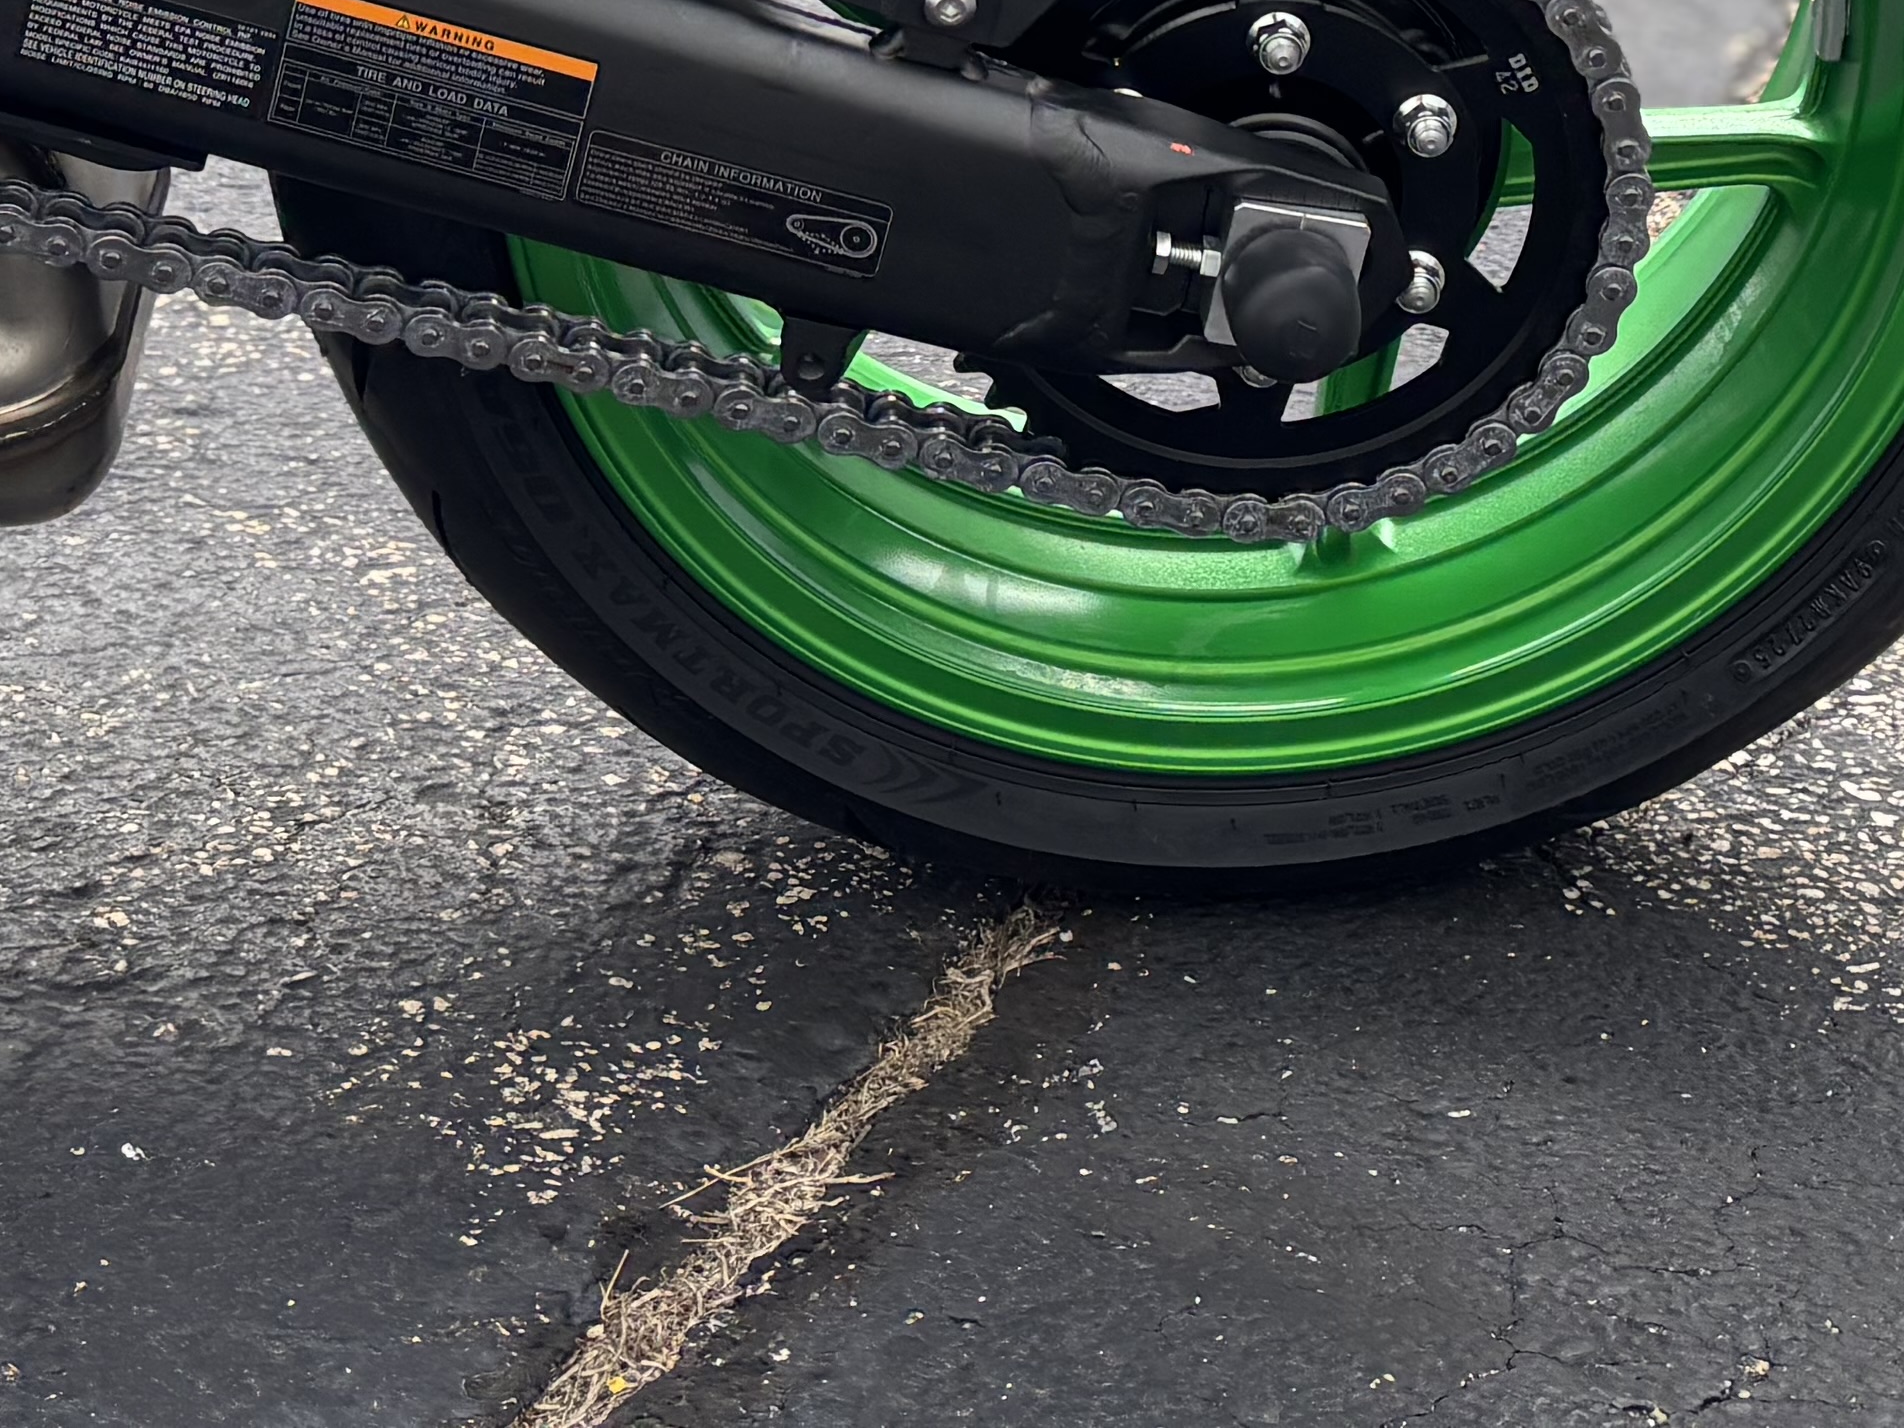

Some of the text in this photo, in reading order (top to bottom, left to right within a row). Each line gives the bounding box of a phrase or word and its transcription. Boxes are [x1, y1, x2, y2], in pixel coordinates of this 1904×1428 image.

[25, 30, 53, 43] MODEL
[55, 38, 90, 53] SPECIFIC
[27, 21, 38, 30] BY
[42, 26, 78, 41] FEDERAL
[109, 43, 124, 53] SEE
[31, 4, 260, 71] MODIFICATIONS WHICH CAUSE THIS MOTORCYCLE TO
[81, 0, 138, 20] MOTORCYCLE
[142, 16, 170, 29] MEETS
[174, 25, 191, 35] EPA
[195, 30, 220, 43] NOISE
[225, 38, 265, 55] EMISSION
[101, 14, 112, 22] BY
[118, 18, 133, 28] THE
[137, 24, 173, 39] FEDERAL
[179, 35, 198, 46] TEST
[203, 42, 256, 62] PROCEDURE.
[148, 6, 188, 23] EMISSION
[193, 19, 232, 35] CONTROL
[291, 30, 309, 40] See
[297, 4, 316, 14] Use
[329, 13, 350, 24] tires
[471, 51, 518, 69] excessive
[414, 19, 496, 53] WARNING
[20, 48, 46, 61] NOISE
[29, 12, 61, 27] EXCEED
[65, 22, 101, 37] FEDERAL
[106, 33, 131, 45] NOISE
[136, 42, 186, 60] STANDARDS
[190, 56, 206, 66] ARE
[210, 62, 260, 80] PROHIBITED
[346, 27, 404, 47] replacement
[406, 42, 426, 53] tires
[428, 48, 439, 57] or
[441, 52, 496, 72] overloading
[498, 67, 516, 77] can
[518, 72, 545, 85] result
[346, 36, 380, 50] control
[382, 45, 419, 60] causing
[420, 55, 456, 70] serious
[458, 65, 486, 78] bodily
[22, 38, 38, 49] SEE
[39, 42, 72, 59] VEHICLE
[74, 52, 136, 76] IDENTIFICATION
[137, 69, 172, 86] NUMBER
[173, 79, 185, 89] ON
[187, 82, 226, 100] STEERING
[227, 93, 250, 107] HEAD
[355, 66, 387, 83] TIRE
[392, 76, 422, 92] AND
[428, 85, 467, 104] LOAD
[473, 97, 509, 115] DATA
[1495, 72, 1519, 95] 42
[1508, 53, 1539, 93] DID
[660, 150, 823, 203] CHAIN INFORMATION
[570, 541, 866, 768] SPORTMAX
